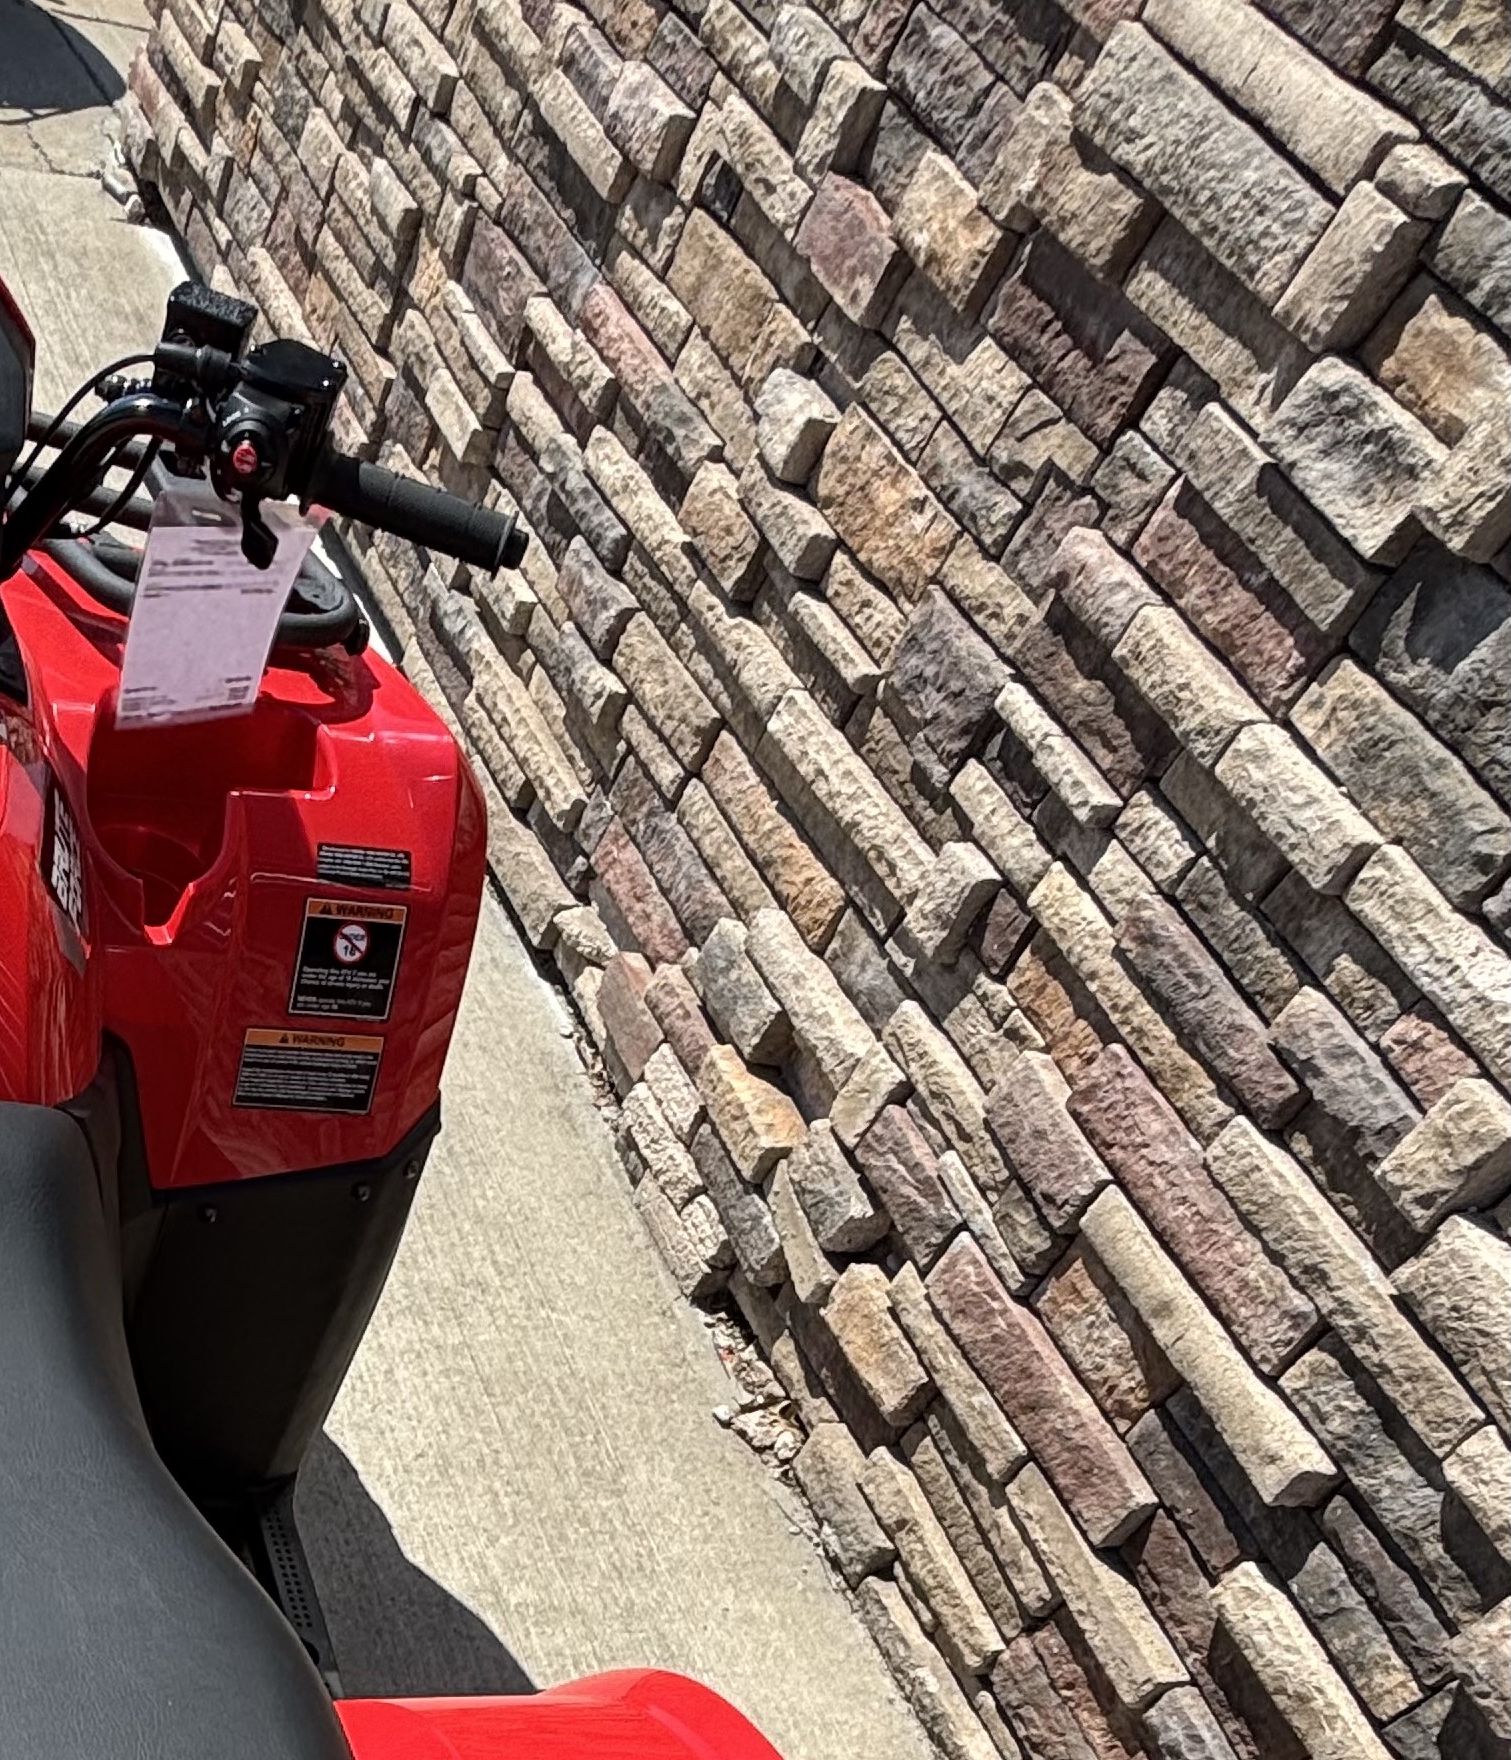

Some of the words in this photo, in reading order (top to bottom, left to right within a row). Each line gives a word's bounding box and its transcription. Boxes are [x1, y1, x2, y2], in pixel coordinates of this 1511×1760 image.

[336, 903, 394, 920] WARNING
[343, 945, 356, 957] 16
[292, 1033, 345, 1047] WARNING
